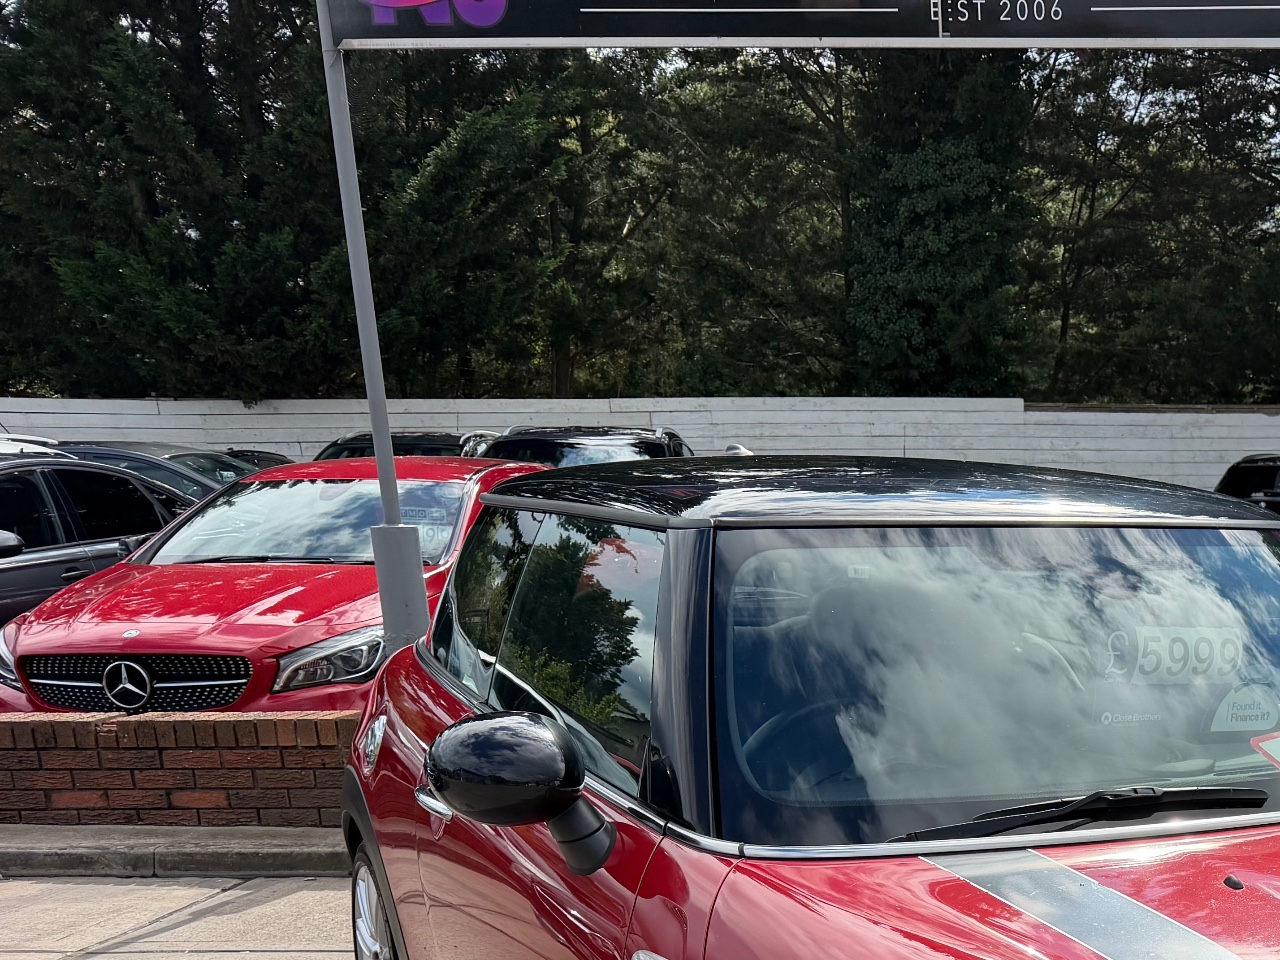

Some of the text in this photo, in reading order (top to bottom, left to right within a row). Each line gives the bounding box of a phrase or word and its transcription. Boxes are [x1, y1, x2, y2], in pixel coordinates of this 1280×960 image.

[1000, 0, 1062, 21] 2006
[1231, 702, 1261, 711] Found it
[1113, 713, 1161, 722] Close Brothers
[1231, 712, 1270, 722] Finance it?
